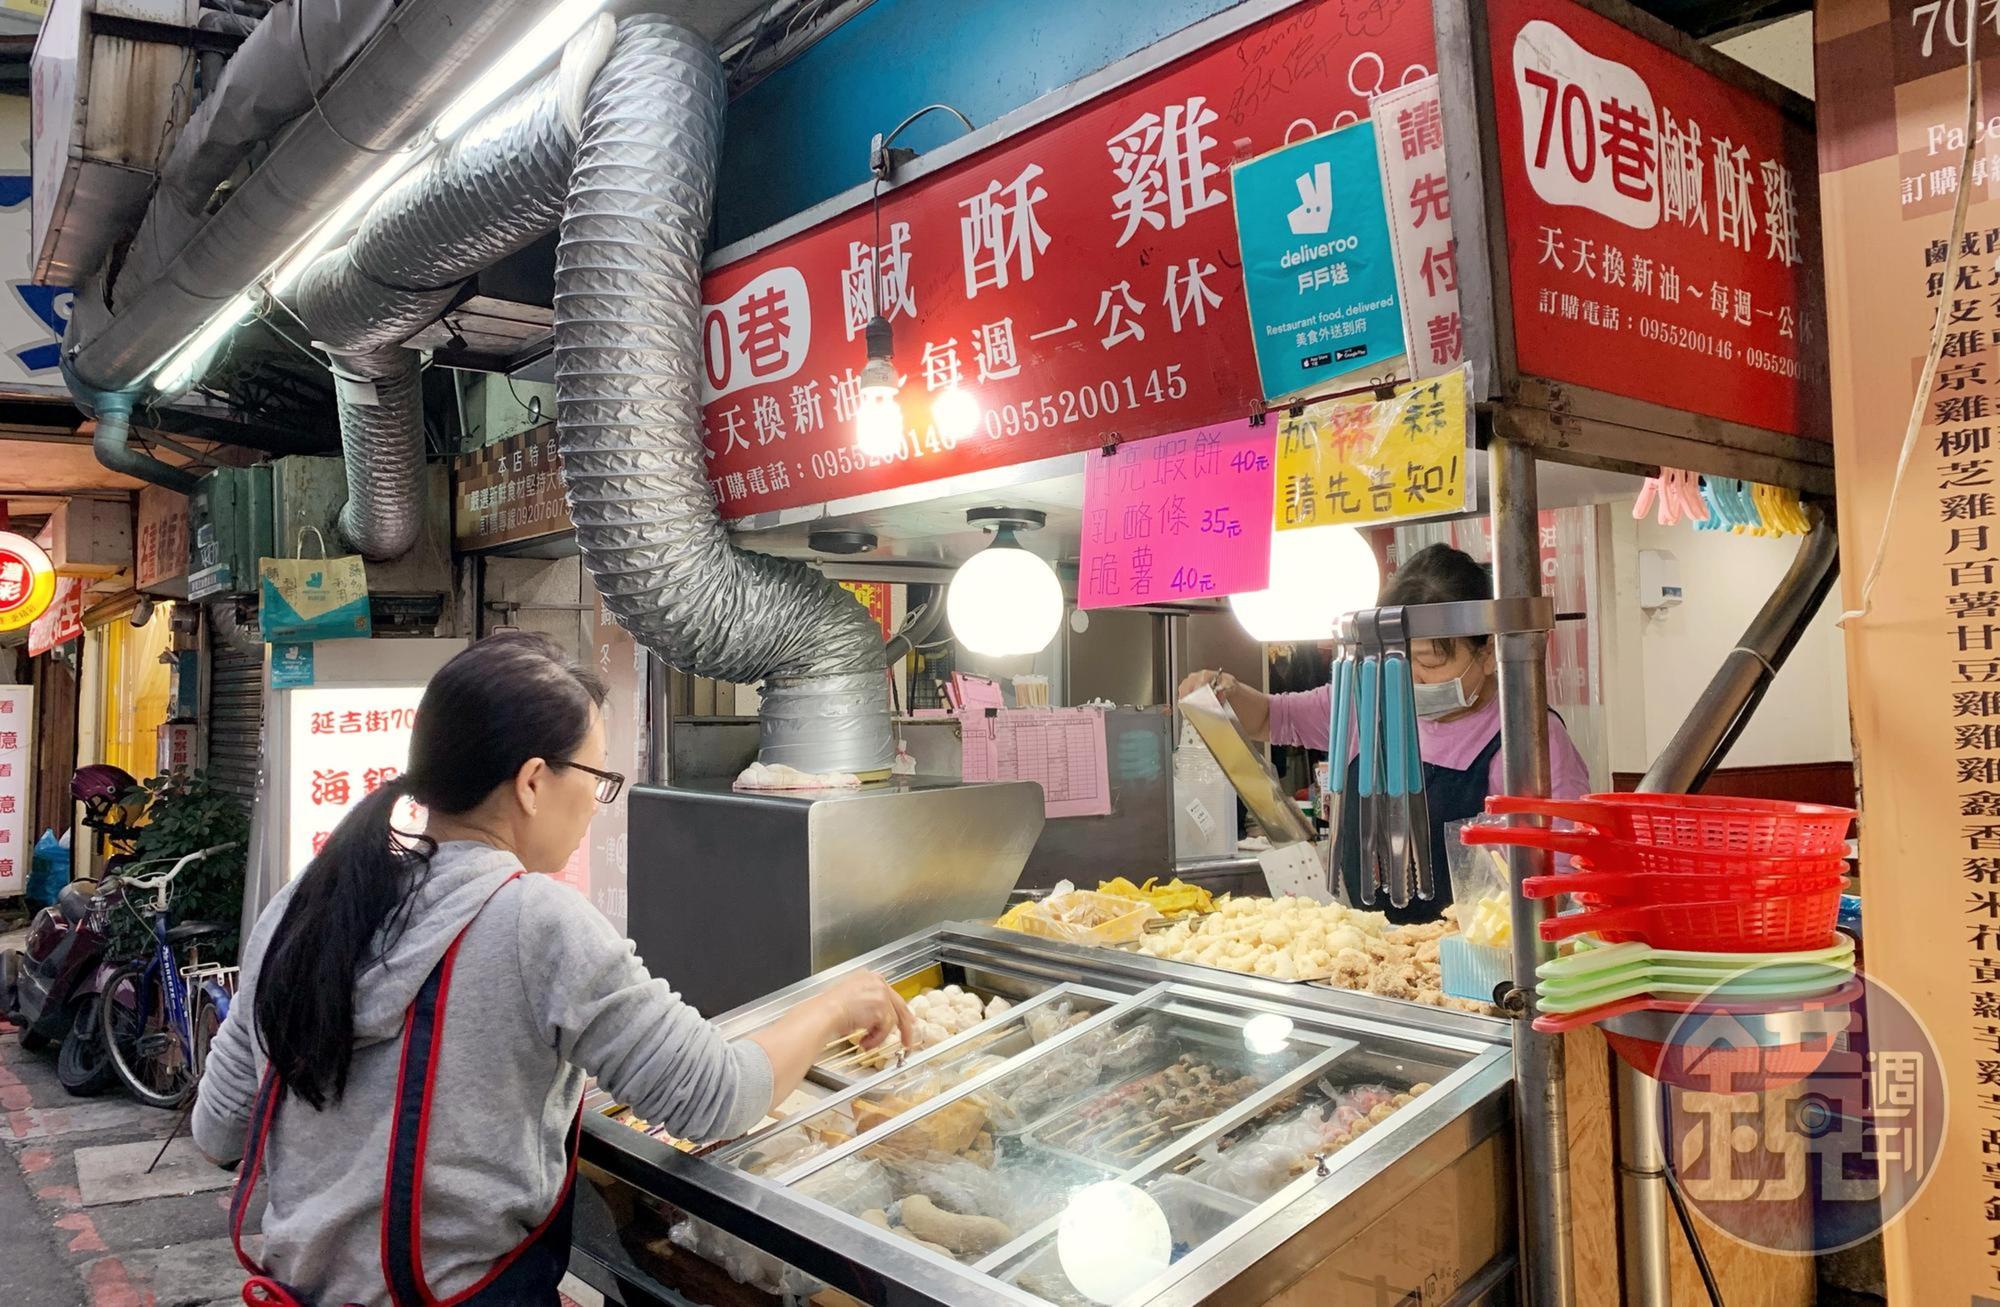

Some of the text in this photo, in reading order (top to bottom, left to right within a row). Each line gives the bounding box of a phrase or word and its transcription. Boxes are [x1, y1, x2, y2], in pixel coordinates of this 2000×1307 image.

[1524, 67, 1804, 268] 70巷 鹹酥雞
[841, 97, 1228, 342] 鹹酥雞
[1397, 98, 1463, 366] 請先付款
[1280, 235, 1358, 269] deliveroo
[1298, 262, 1350, 295] 戶戶送
[1266, 295, 1394, 338] Restaurant food, delivered
[1295, 318, 1368, 348] 美食外送到府
[985, 363, 1188, 440] 0955200145
[497, 438, 557, 477] 本店特色
[1230, 450, 1270, 473] 40元
[1200, 507, 1242, 538] 35元
[311, 708, 415, 736] 延吉街70
